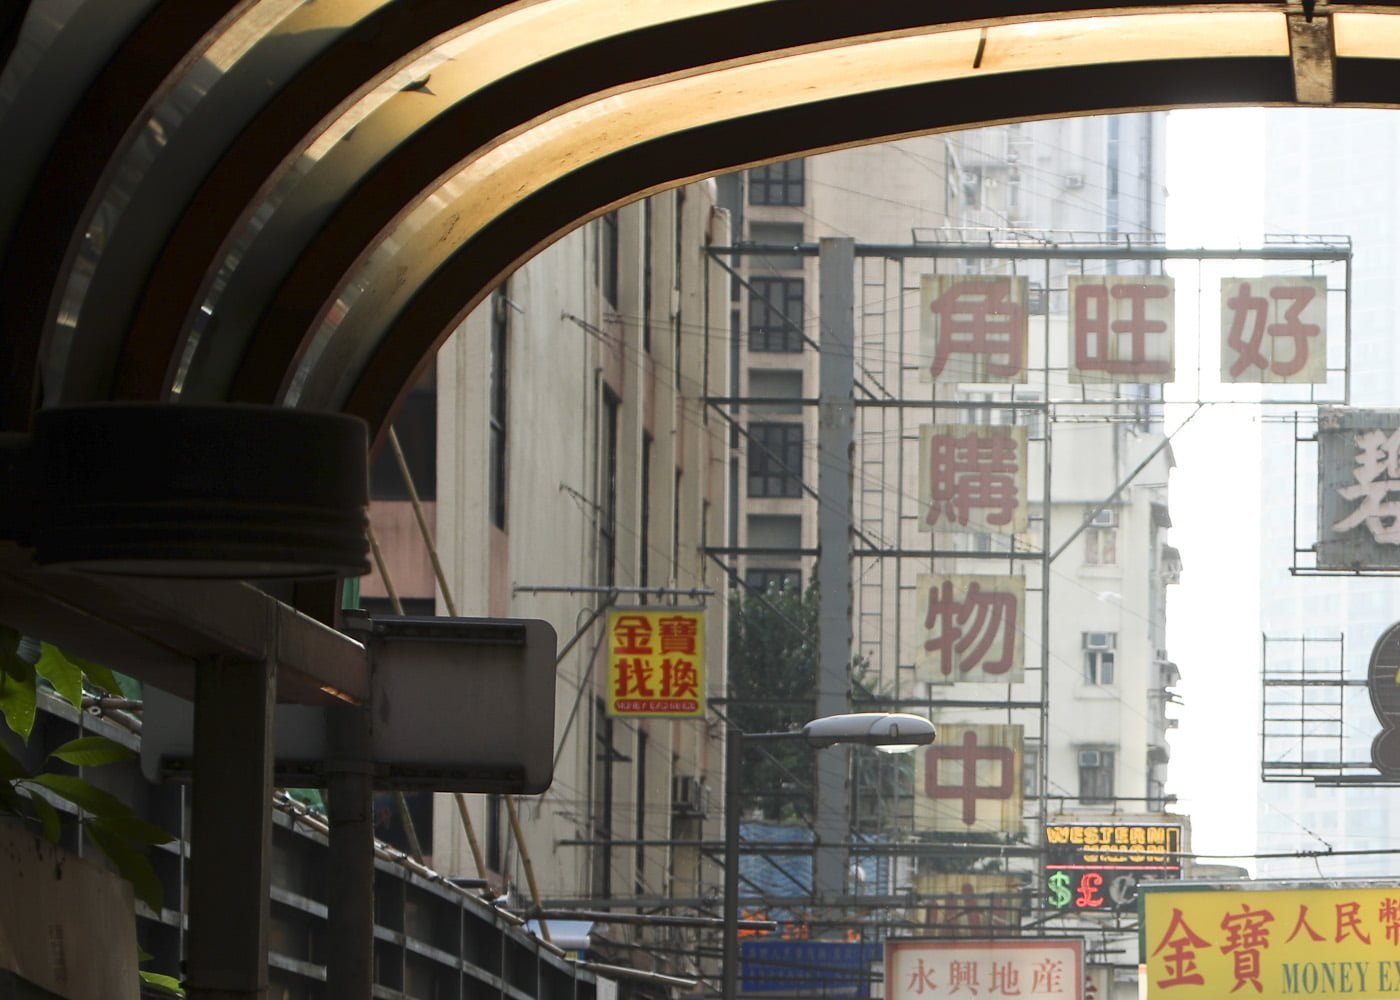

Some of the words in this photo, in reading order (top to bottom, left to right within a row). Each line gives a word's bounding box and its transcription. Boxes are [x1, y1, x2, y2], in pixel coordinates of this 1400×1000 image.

[614, 615, 698, 656] 金寶
[614, 658, 698, 698] 找換
[1046, 827, 1166, 844] WESTERN
[1083, 845, 1167, 862] UNION
[1151, 903, 1276, 994] 金寶
[1280, 962, 1369, 995] MONEY
